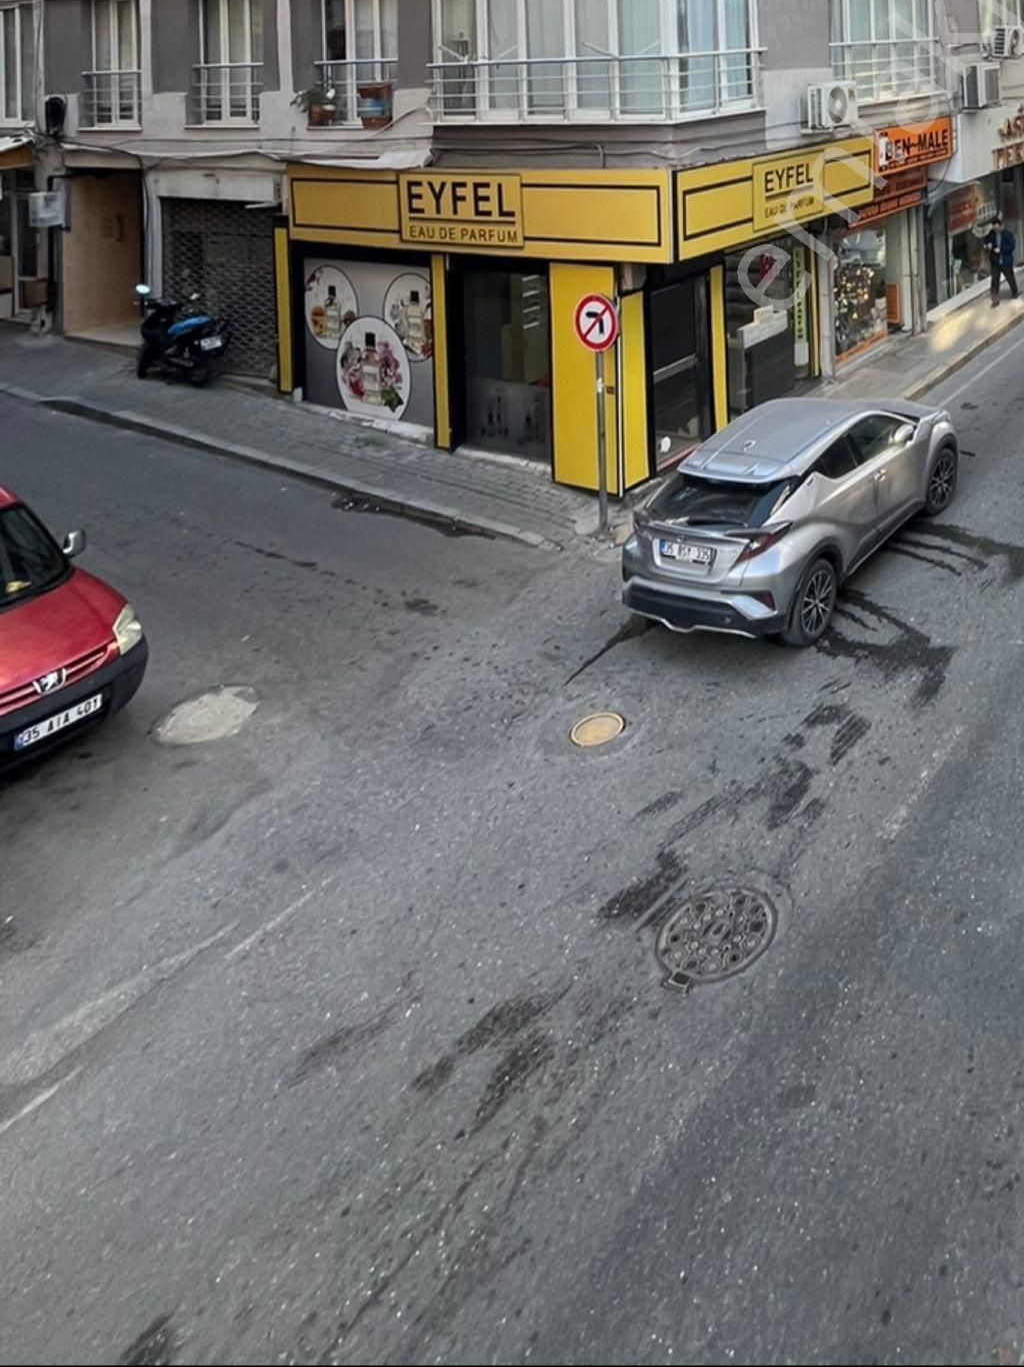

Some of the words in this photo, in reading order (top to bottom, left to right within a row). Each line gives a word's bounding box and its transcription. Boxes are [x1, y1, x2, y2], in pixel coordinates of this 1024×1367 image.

[765, 163, 813, 192] EYFEL
[406, 181, 515, 217] EYFEL
[409, 226, 435, 239] EAU
[438, 227, 456, 240] DE
[460, 228, 518, 243] PARFUM
[24, 726, 40, 743] 35
[77, 697, 98, 716] 401
